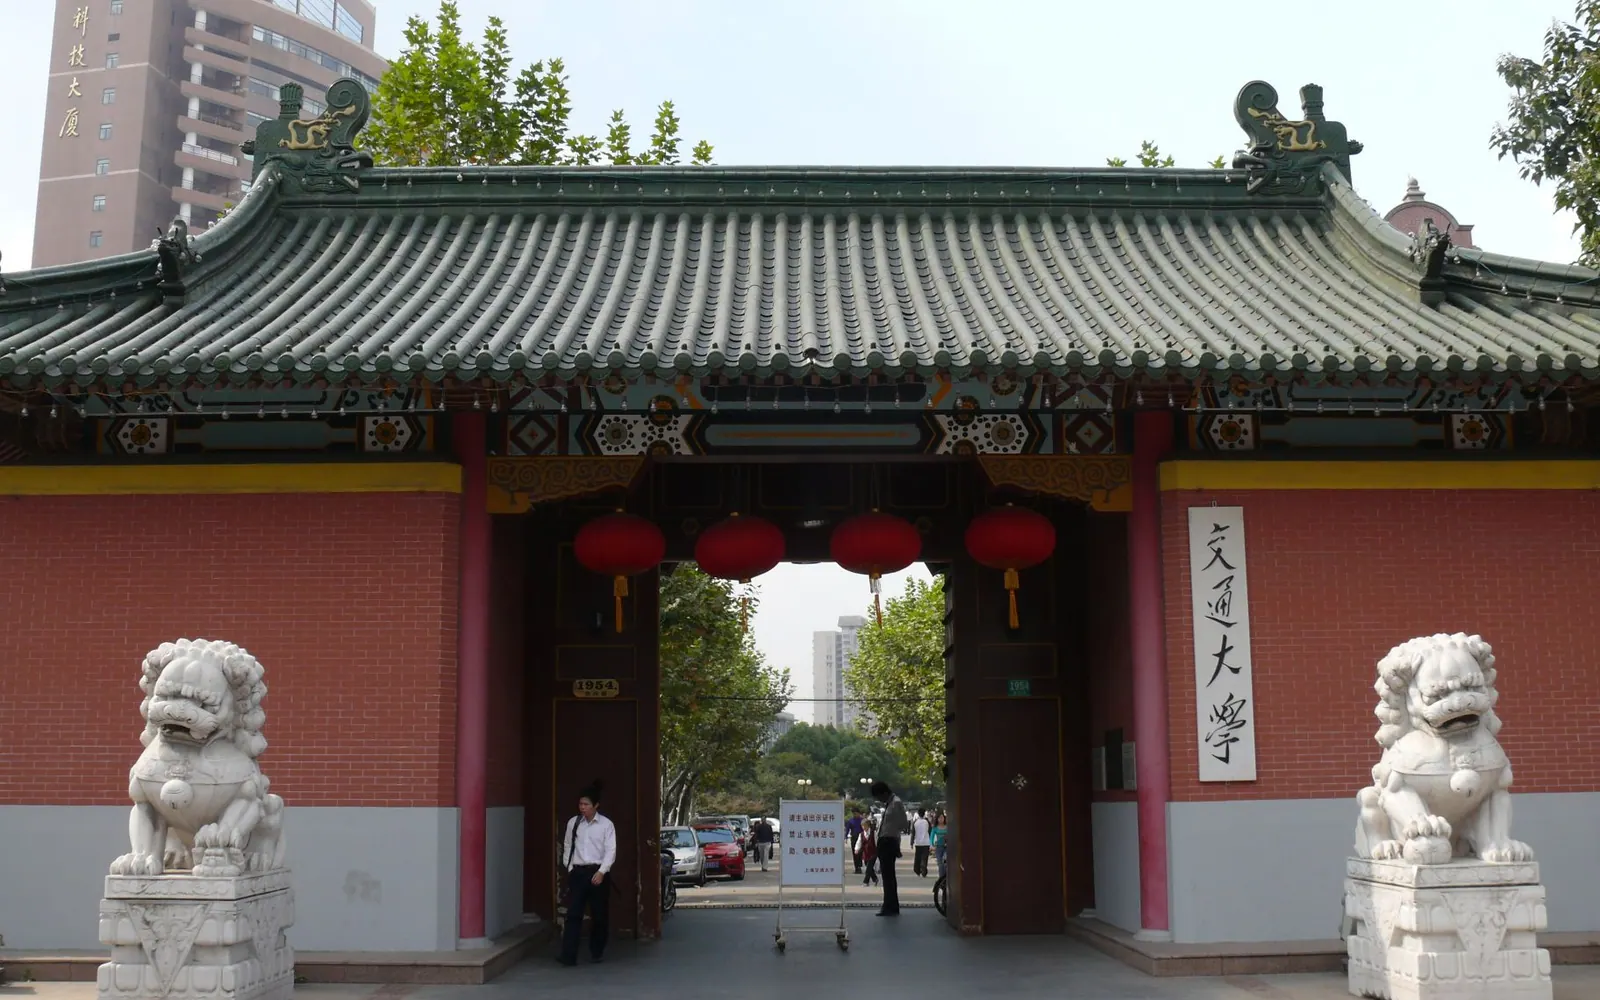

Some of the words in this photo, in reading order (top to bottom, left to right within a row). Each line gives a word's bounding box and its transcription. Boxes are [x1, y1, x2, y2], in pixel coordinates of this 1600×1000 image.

[59, 5, 89, 138] 科技大厦
[789, 814, 835, 822] 请主动出示证件
